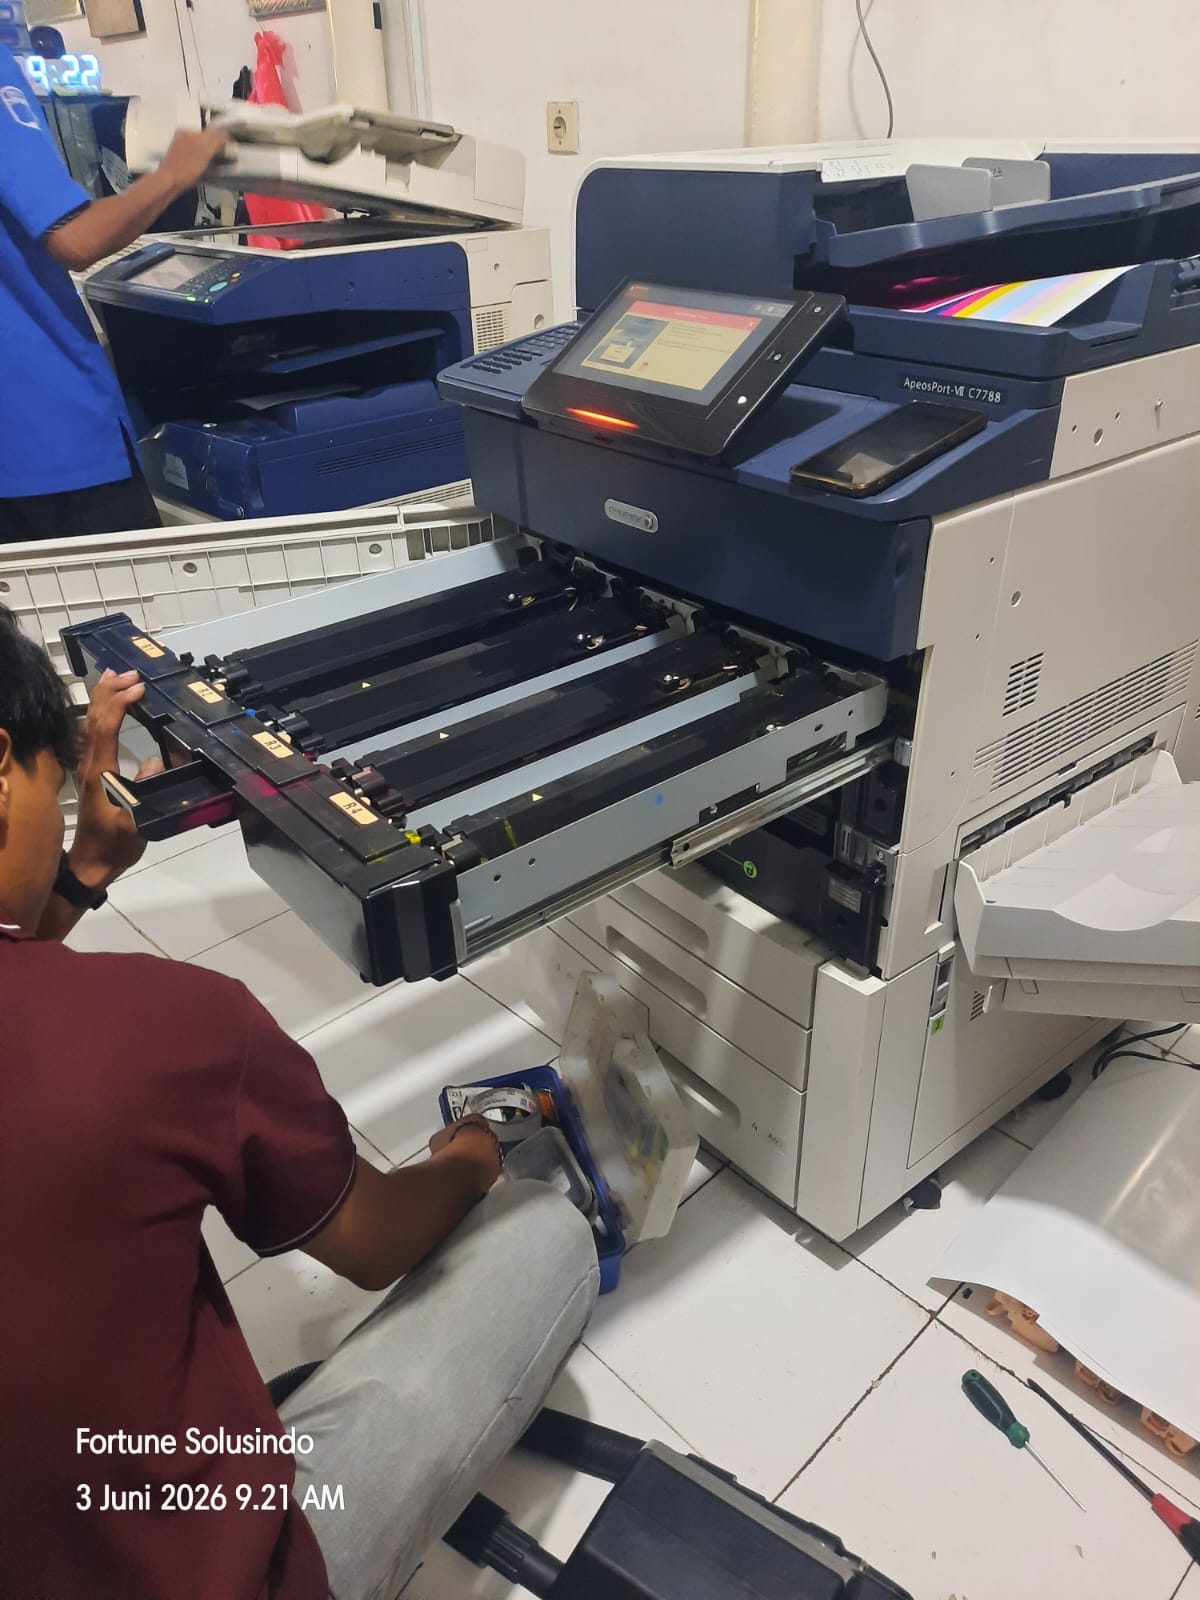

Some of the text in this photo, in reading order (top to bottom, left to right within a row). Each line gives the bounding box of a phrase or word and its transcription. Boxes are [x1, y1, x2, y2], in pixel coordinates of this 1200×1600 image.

[27, 54, 99, 91] 9:22
[968, 387, 1001, 403] C7788
[264, 739, 282, 751] R3
[343, 801, 363, 815] R4
